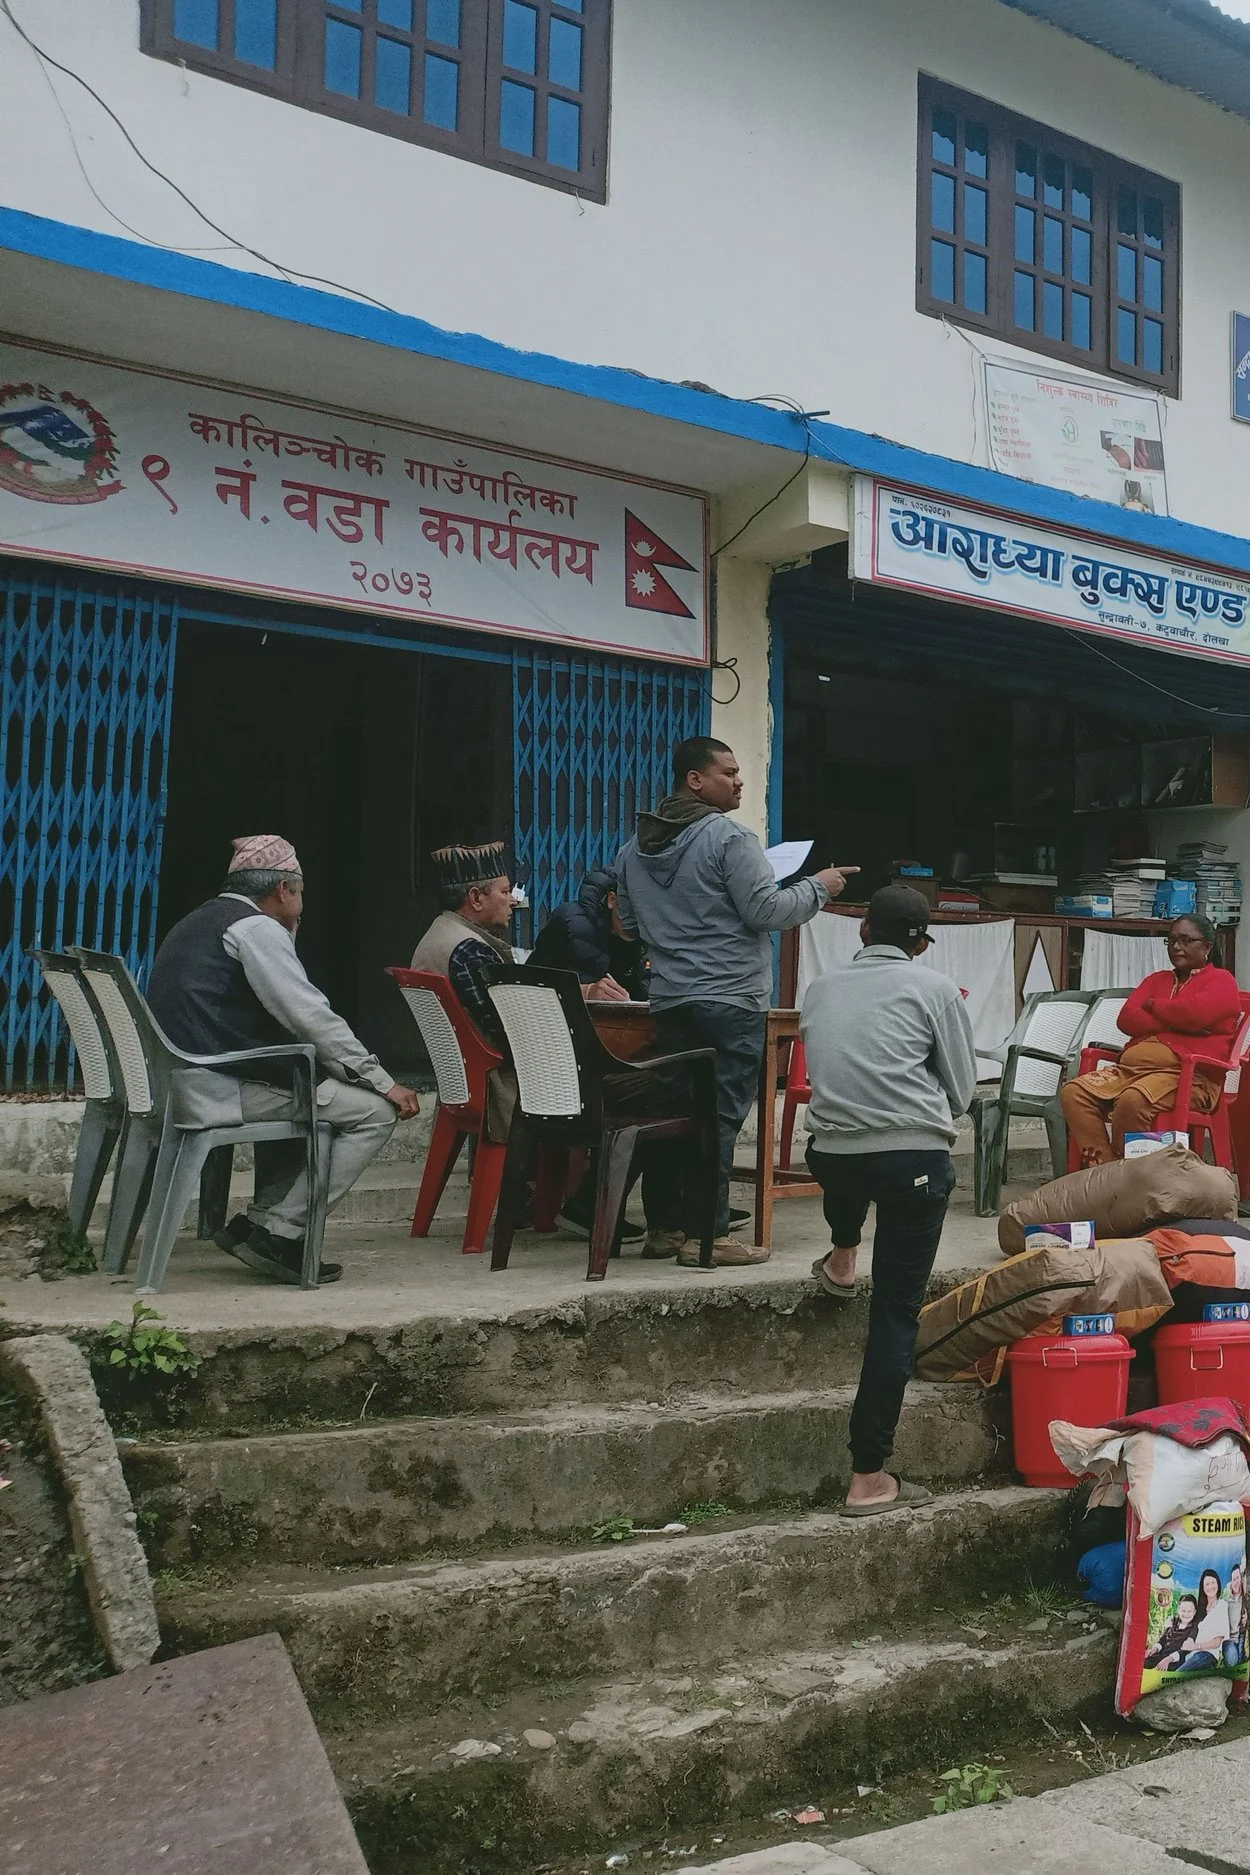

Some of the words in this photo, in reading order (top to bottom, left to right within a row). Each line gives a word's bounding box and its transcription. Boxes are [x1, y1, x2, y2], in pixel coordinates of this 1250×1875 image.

[405, 459, 578, 519] गाउँपालिका
[140, 454, 178, 515] ९
[281, 480, 390, 545] वडा
[419, 507, 599, 585] कार्यलय
[350, 560, 432, 607] २०७३
[889, 507, 1064, 579] आराध्या
[1072, 556, 1168, 611] बुक्स
[1175, 580, 1247, 624] एण्ड
[1202, 632, 1230, 647] दोलखा
[1193, 1518, 1231, 1533] STEAM
